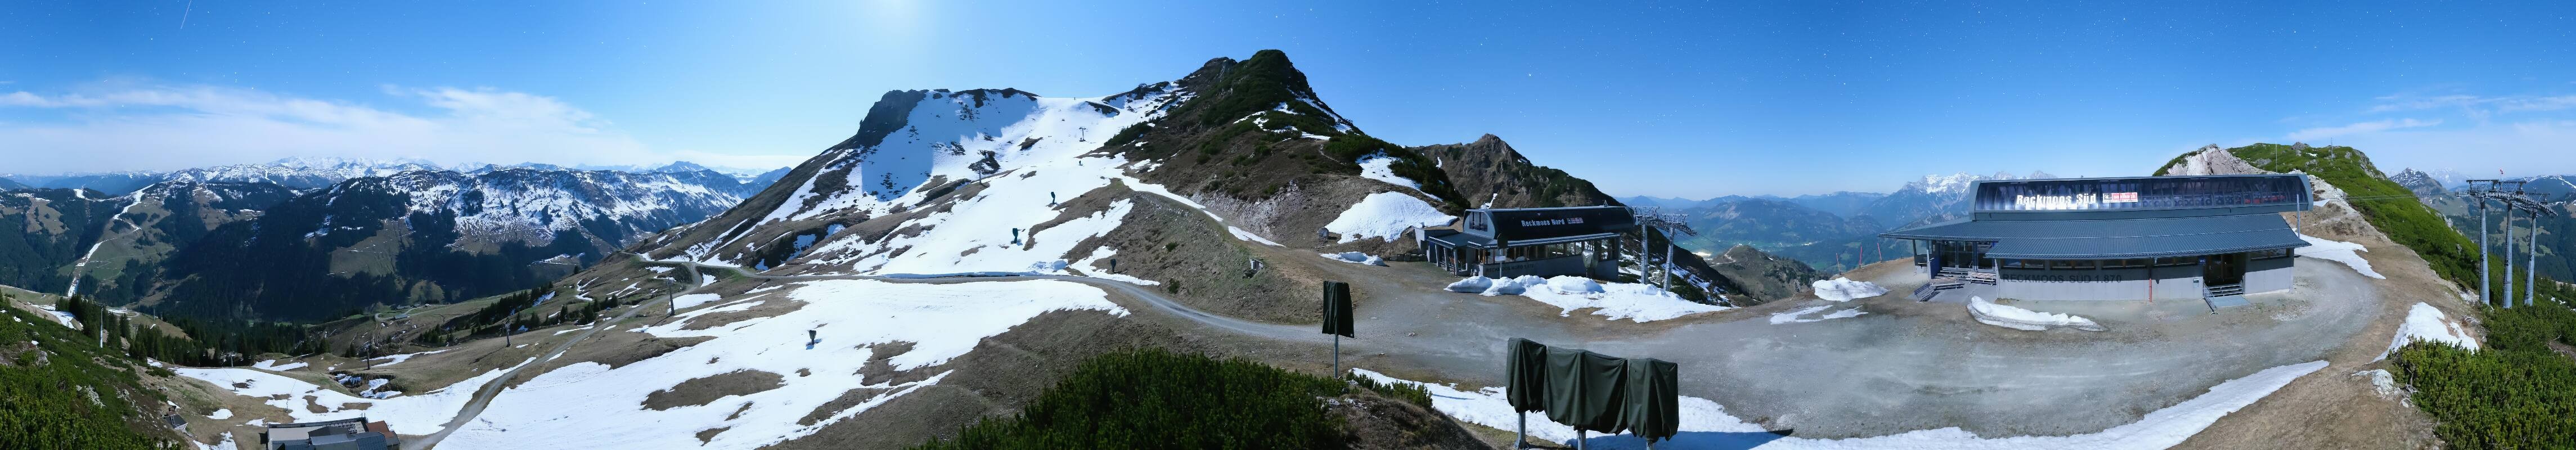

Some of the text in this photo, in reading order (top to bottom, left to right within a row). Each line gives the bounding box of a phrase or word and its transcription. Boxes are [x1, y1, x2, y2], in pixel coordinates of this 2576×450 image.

[2016, 193, 2096, 204] Reckmoos Süd
[2003, 273, 2064, 284] RECKMOOS
[2094, 274, 2122, 284] 1.870
